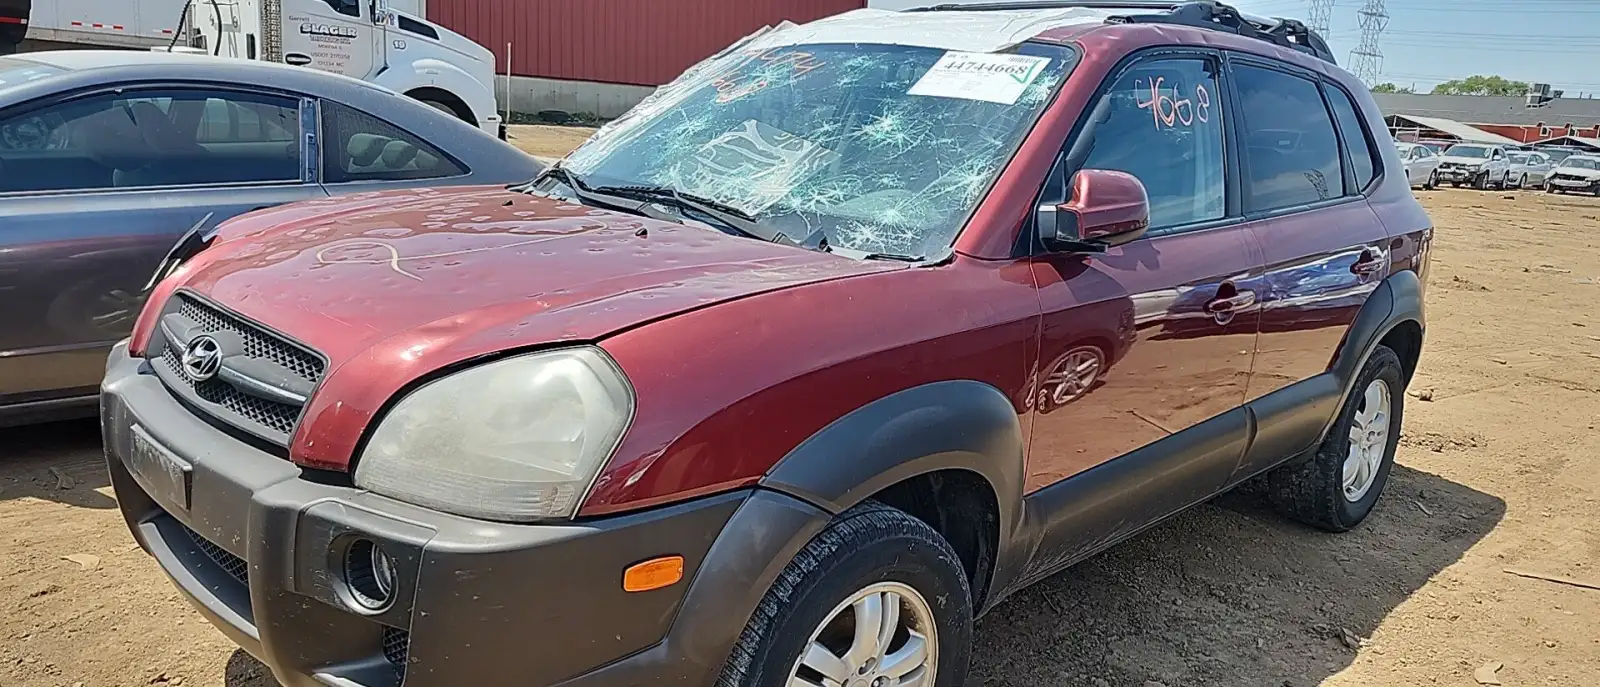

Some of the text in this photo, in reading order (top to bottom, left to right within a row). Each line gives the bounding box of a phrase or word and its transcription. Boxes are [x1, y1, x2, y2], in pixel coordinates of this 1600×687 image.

[300, 23, 357, 38] SLAGER
[944, 61, 1028, 75] 44744668
[1134, 75, 1210, 132] 4668
